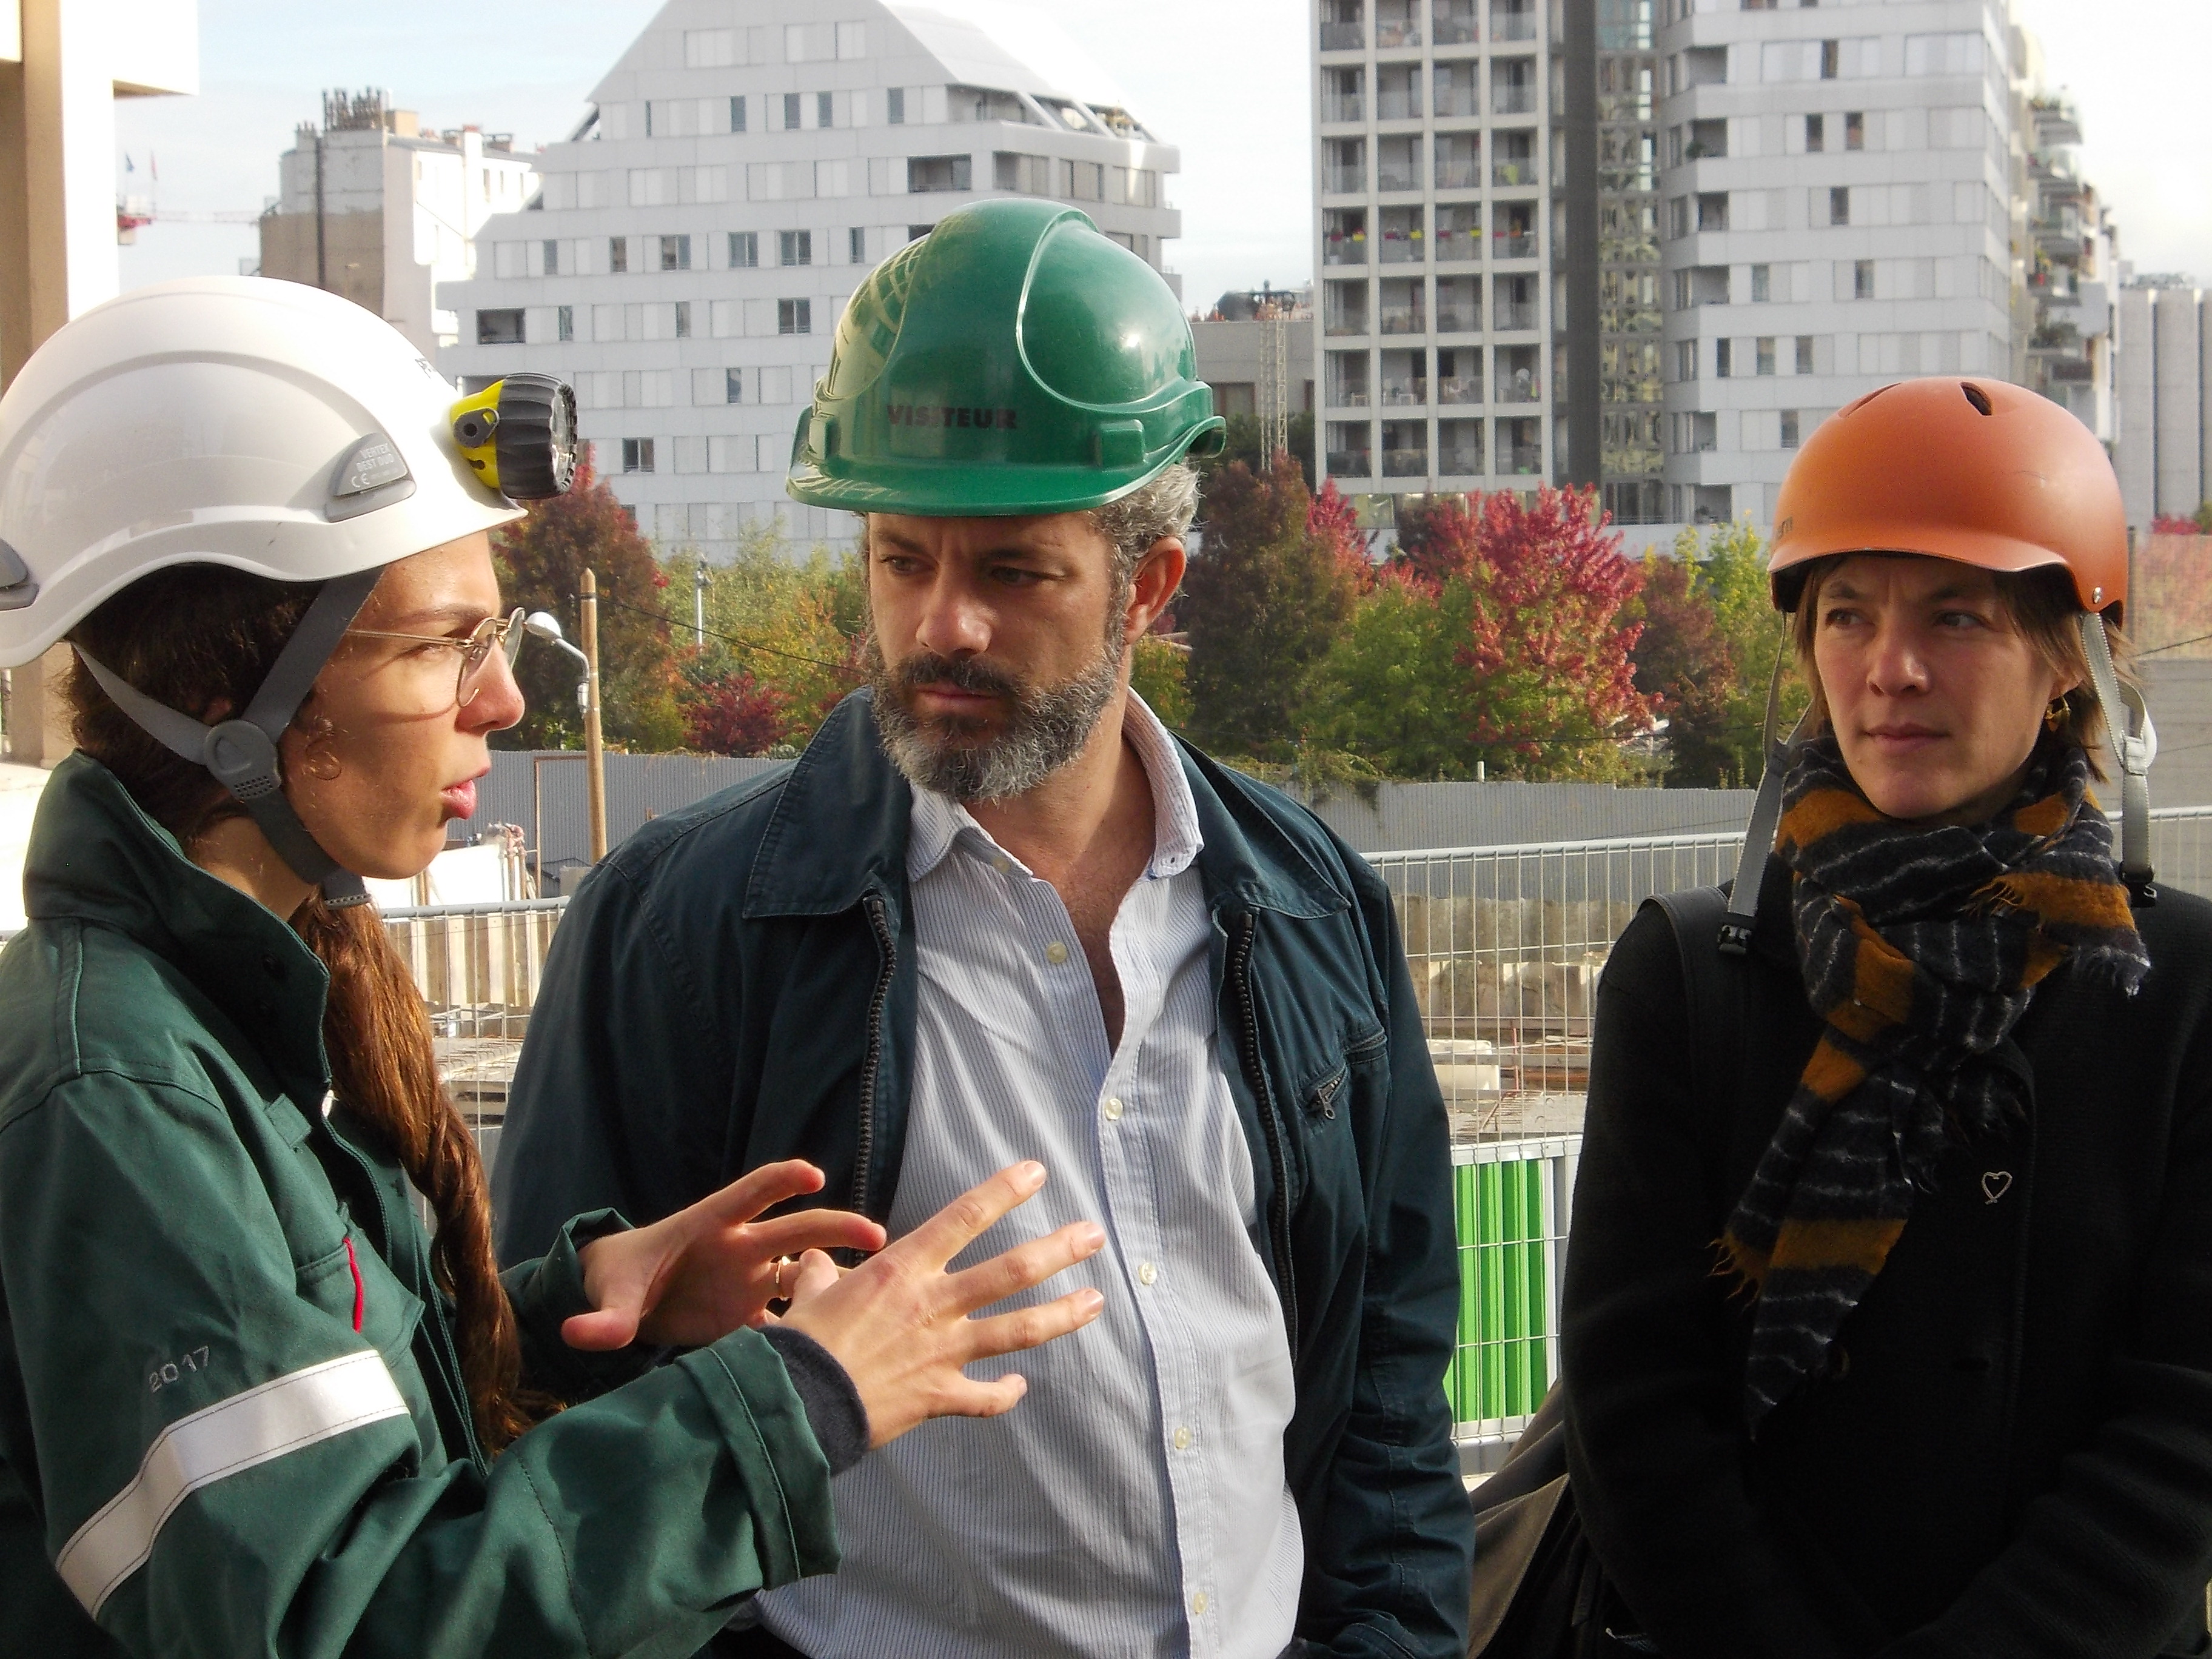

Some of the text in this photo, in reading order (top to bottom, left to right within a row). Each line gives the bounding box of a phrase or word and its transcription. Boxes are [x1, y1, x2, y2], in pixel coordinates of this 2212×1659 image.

[886, 404, 1017, 429] VISITEUR
[356, 454, 394, 472] BEST DUO
[149, 1346, 209, 1393] 2017
